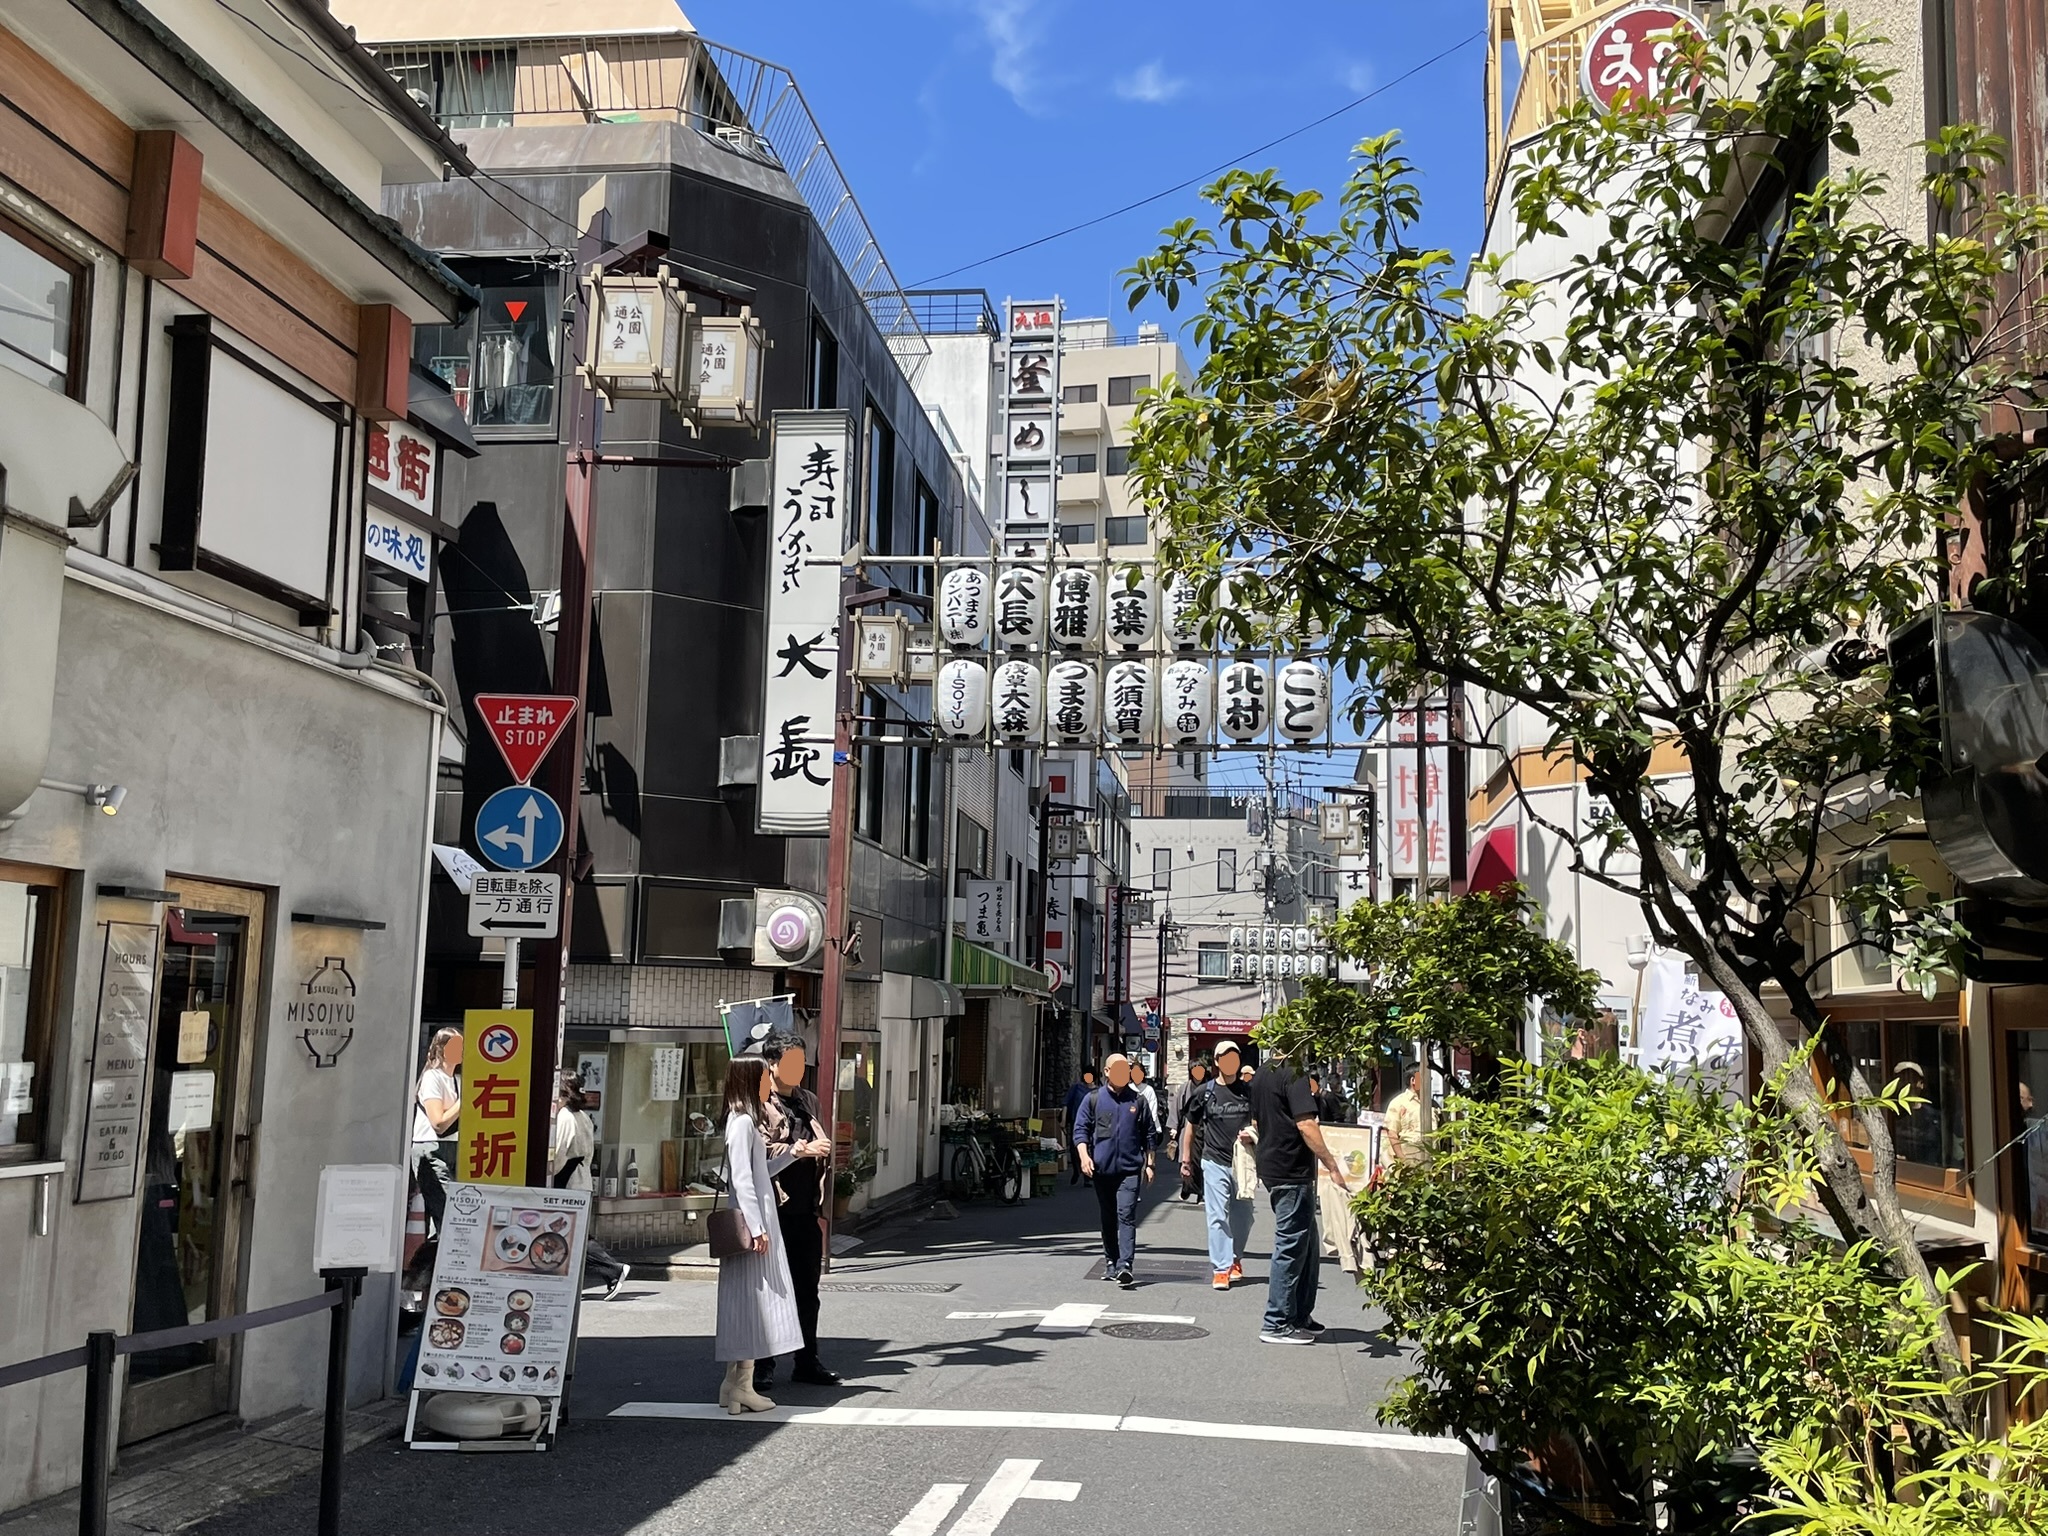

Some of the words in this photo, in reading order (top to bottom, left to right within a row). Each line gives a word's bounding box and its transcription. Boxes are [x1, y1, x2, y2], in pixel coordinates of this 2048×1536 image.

[612, 305, 628, 350] 通り会
[629, 305, 643, 335] 公園
[700, 343, 714, 384] 通り会
[714, 343, 728, 370] 公園
[800, 442, 840, 522] 寿司
[368, 523, 425, 572] の味処
[964, 571, 982, 629] あつまる
[998, 571, 1036, 636] 大長
[1054, 571, 1092, 638] 博雅
[868, 633, 877, 660] 通り会
[877, 633, 886, 651] 公園
[914, 639, 922, 664] 通会
[766, 630, 833, 787] 大長
[951, 662, 968, 729] MISOJYU
[1000, 664, 1031, 732] 浅草大森
[1055, 664, 1088, 735] つま亀
[1114, 664, 1147, 734] 大須賀
[1226, 666, 1265, 731] 北村
[1283, 668, 1316, 732] こと
[495, 704, 556, 726] 止まれ
[505, 729, 547, 746] STOP
[1394, 763, 1447, 865] 博雅
[475, 877, 554, 893] 自転車を除く
[475, 897, 553, 914] 一方通行
[976, 891, 990, 937] つま亀
[114, 953, 147, 965] HOURS
[287, 1002, 355, 1024] MISOJYU
[306, 1028, 318, 1036] OUP
[325, 1028, 338, 1036] RICE
[106, 1059, 135, 1070] MENU
[99, 1126, 116, 1137] EAT
[119, 1125, 128, 1135] IN
[470, 1073, 520, 1179] 右折
[98, 1152, 110, 1161] TO
[112, 1150, 124, 1160] GO
[108, 1138, 116, 1150] &
[449, 1196, 486, 1205] MISOJYU
[561, 1198, 586, 1206] MENU
